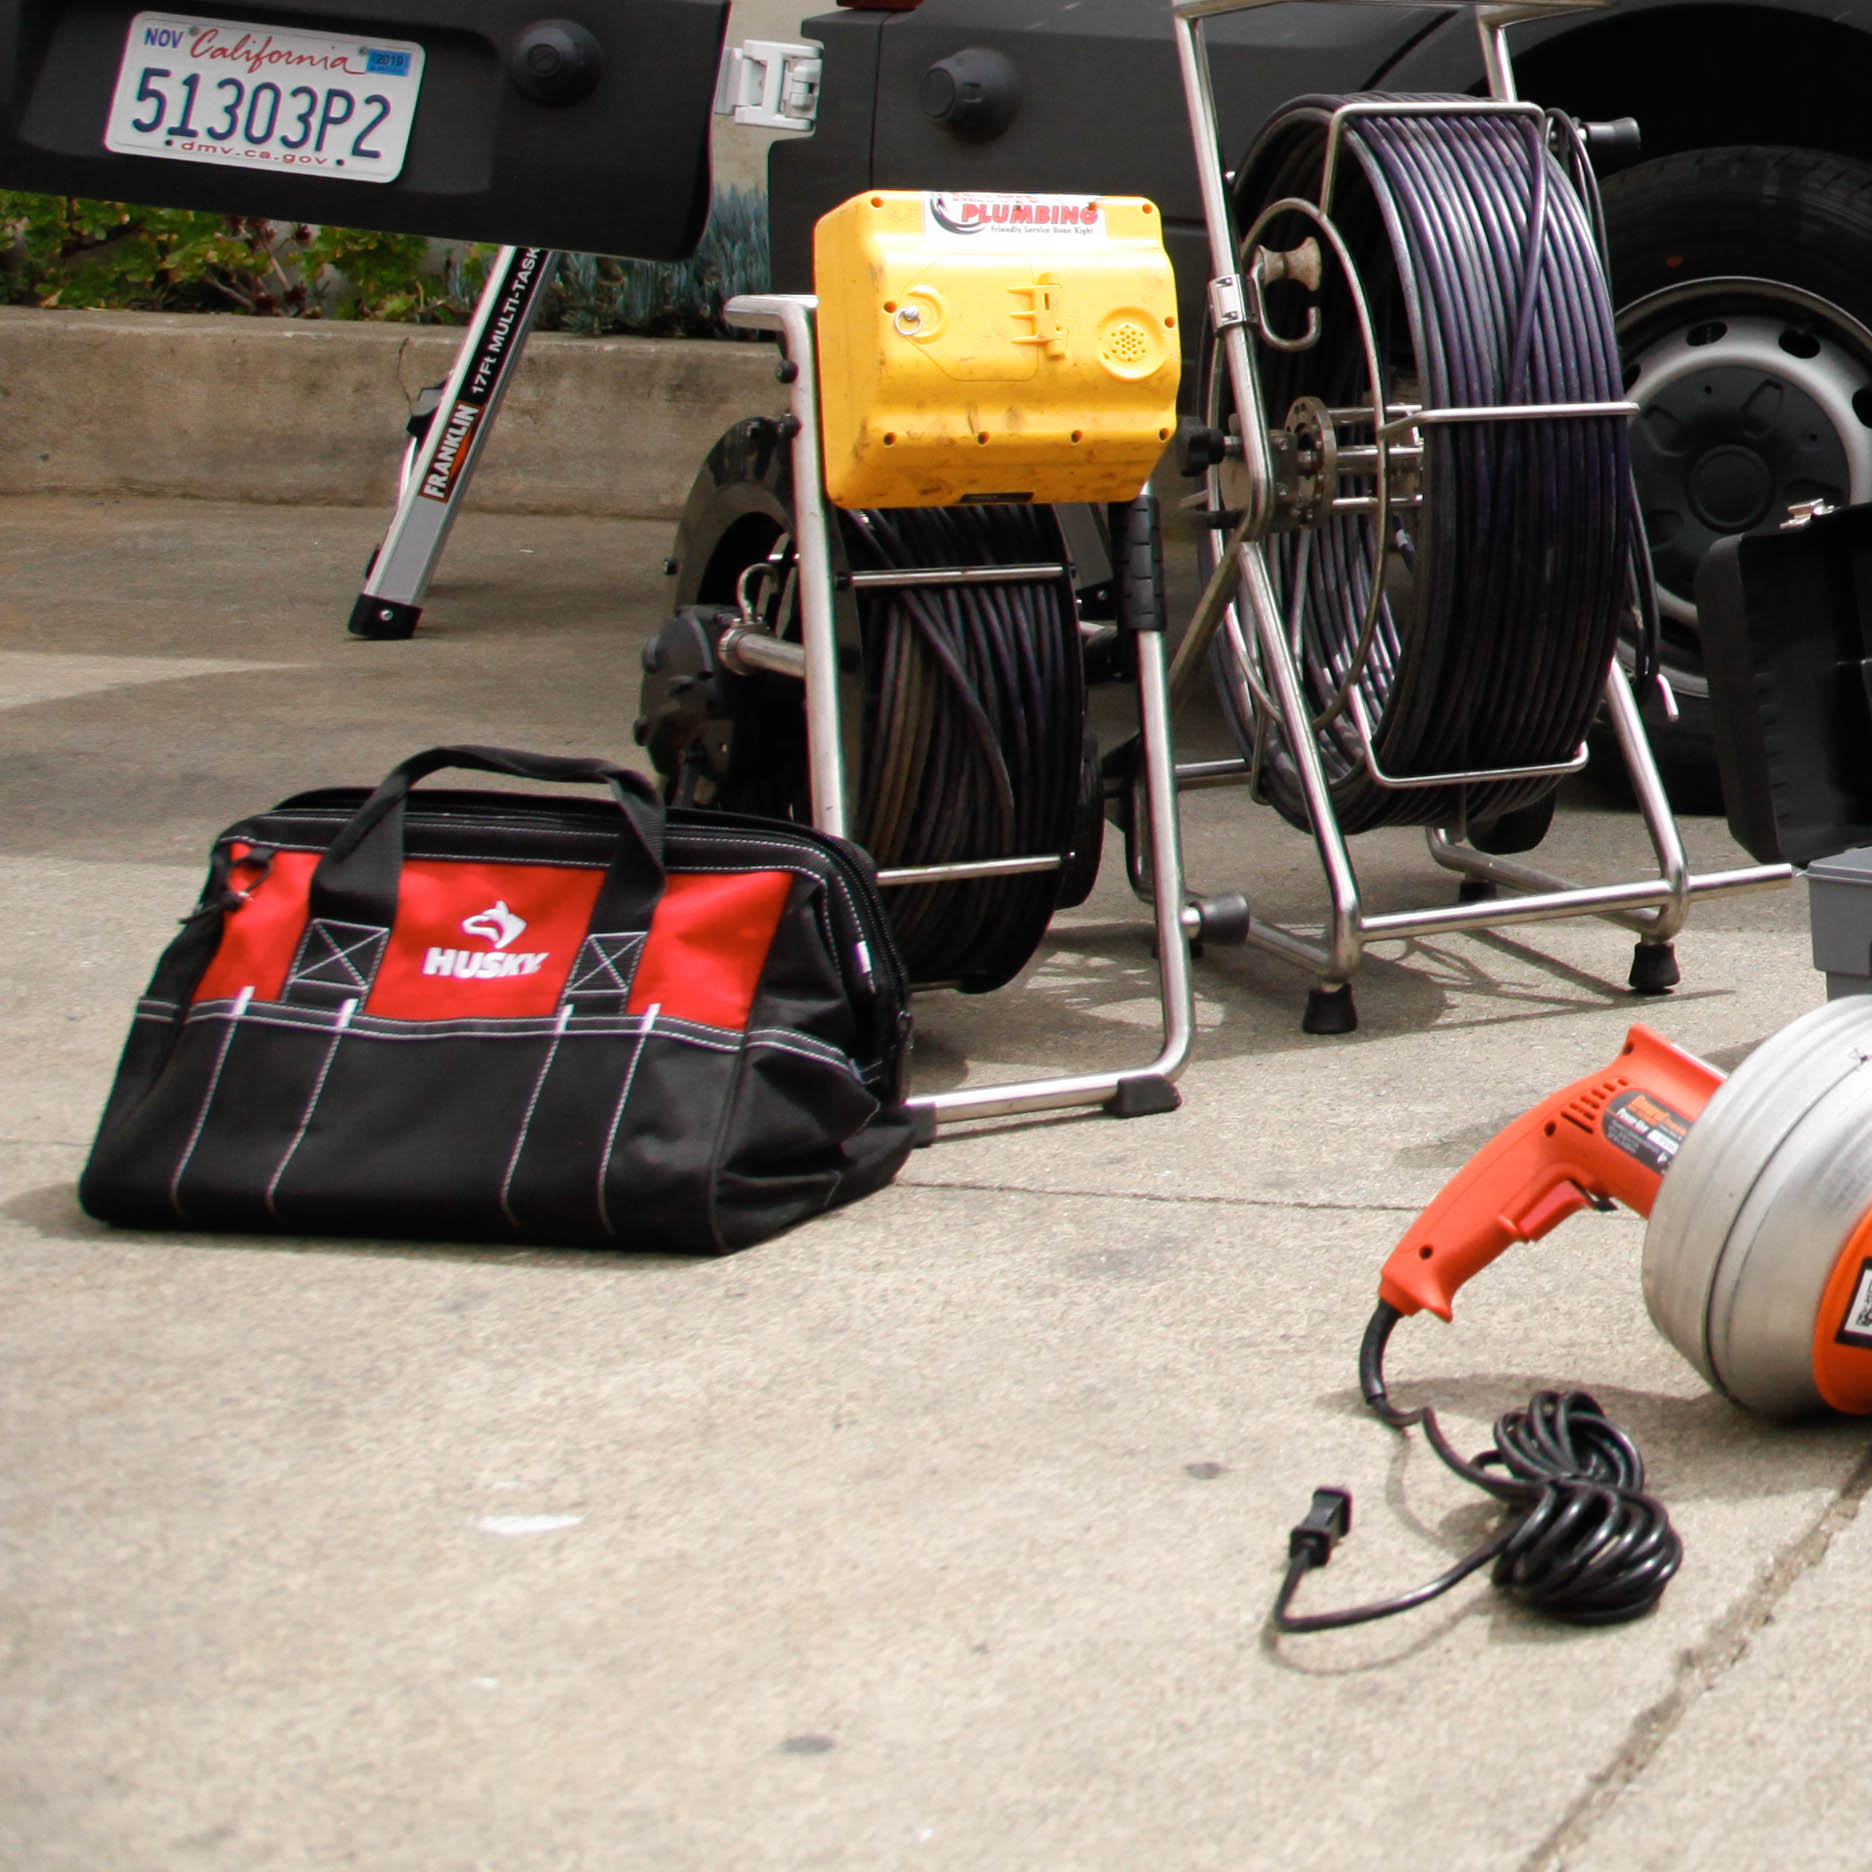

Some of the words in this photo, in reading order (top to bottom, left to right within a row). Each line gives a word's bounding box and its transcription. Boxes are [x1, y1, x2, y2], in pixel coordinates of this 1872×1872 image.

[143, 26, 185, 49] NOV
[188, 28, 368, 75] California
[131, 66, 392, 160] 51303P2
[180, 141, 329, 165] dmv.ca.gov
[961, 202, 1099, 226] PLUMBING
[423, 403, 480, 499] FRANKLIN
[422, 946, 551, 979] HUSKY
